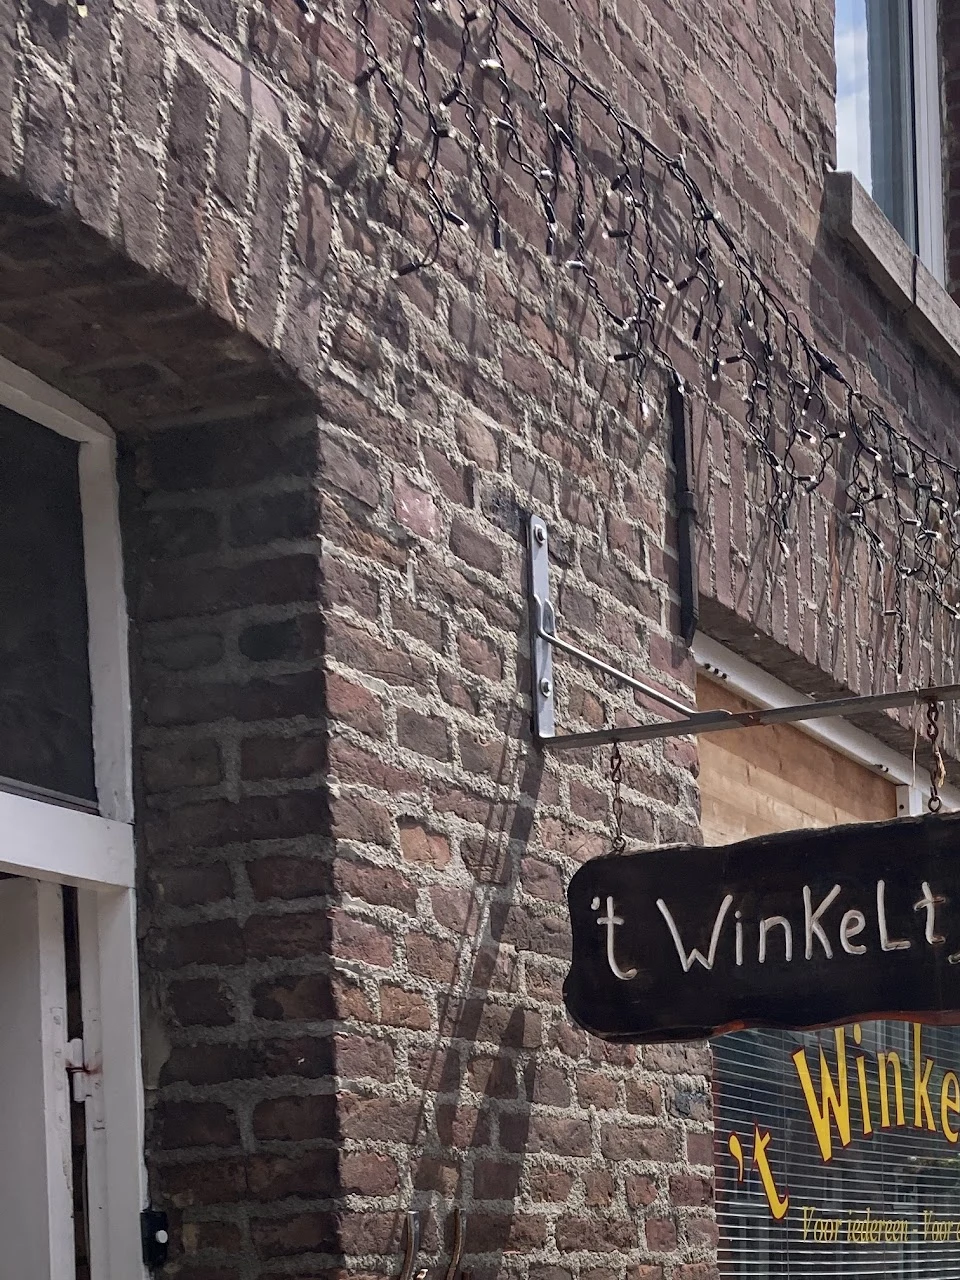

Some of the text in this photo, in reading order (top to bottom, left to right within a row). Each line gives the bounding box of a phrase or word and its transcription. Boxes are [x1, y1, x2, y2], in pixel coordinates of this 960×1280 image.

[591, 896, 638, 980] 't
[802, 1206, 842, 1243] Voor
[847, 1207, 908, 1243] iedereen
[923, 1210, 954, 1241] Voor
